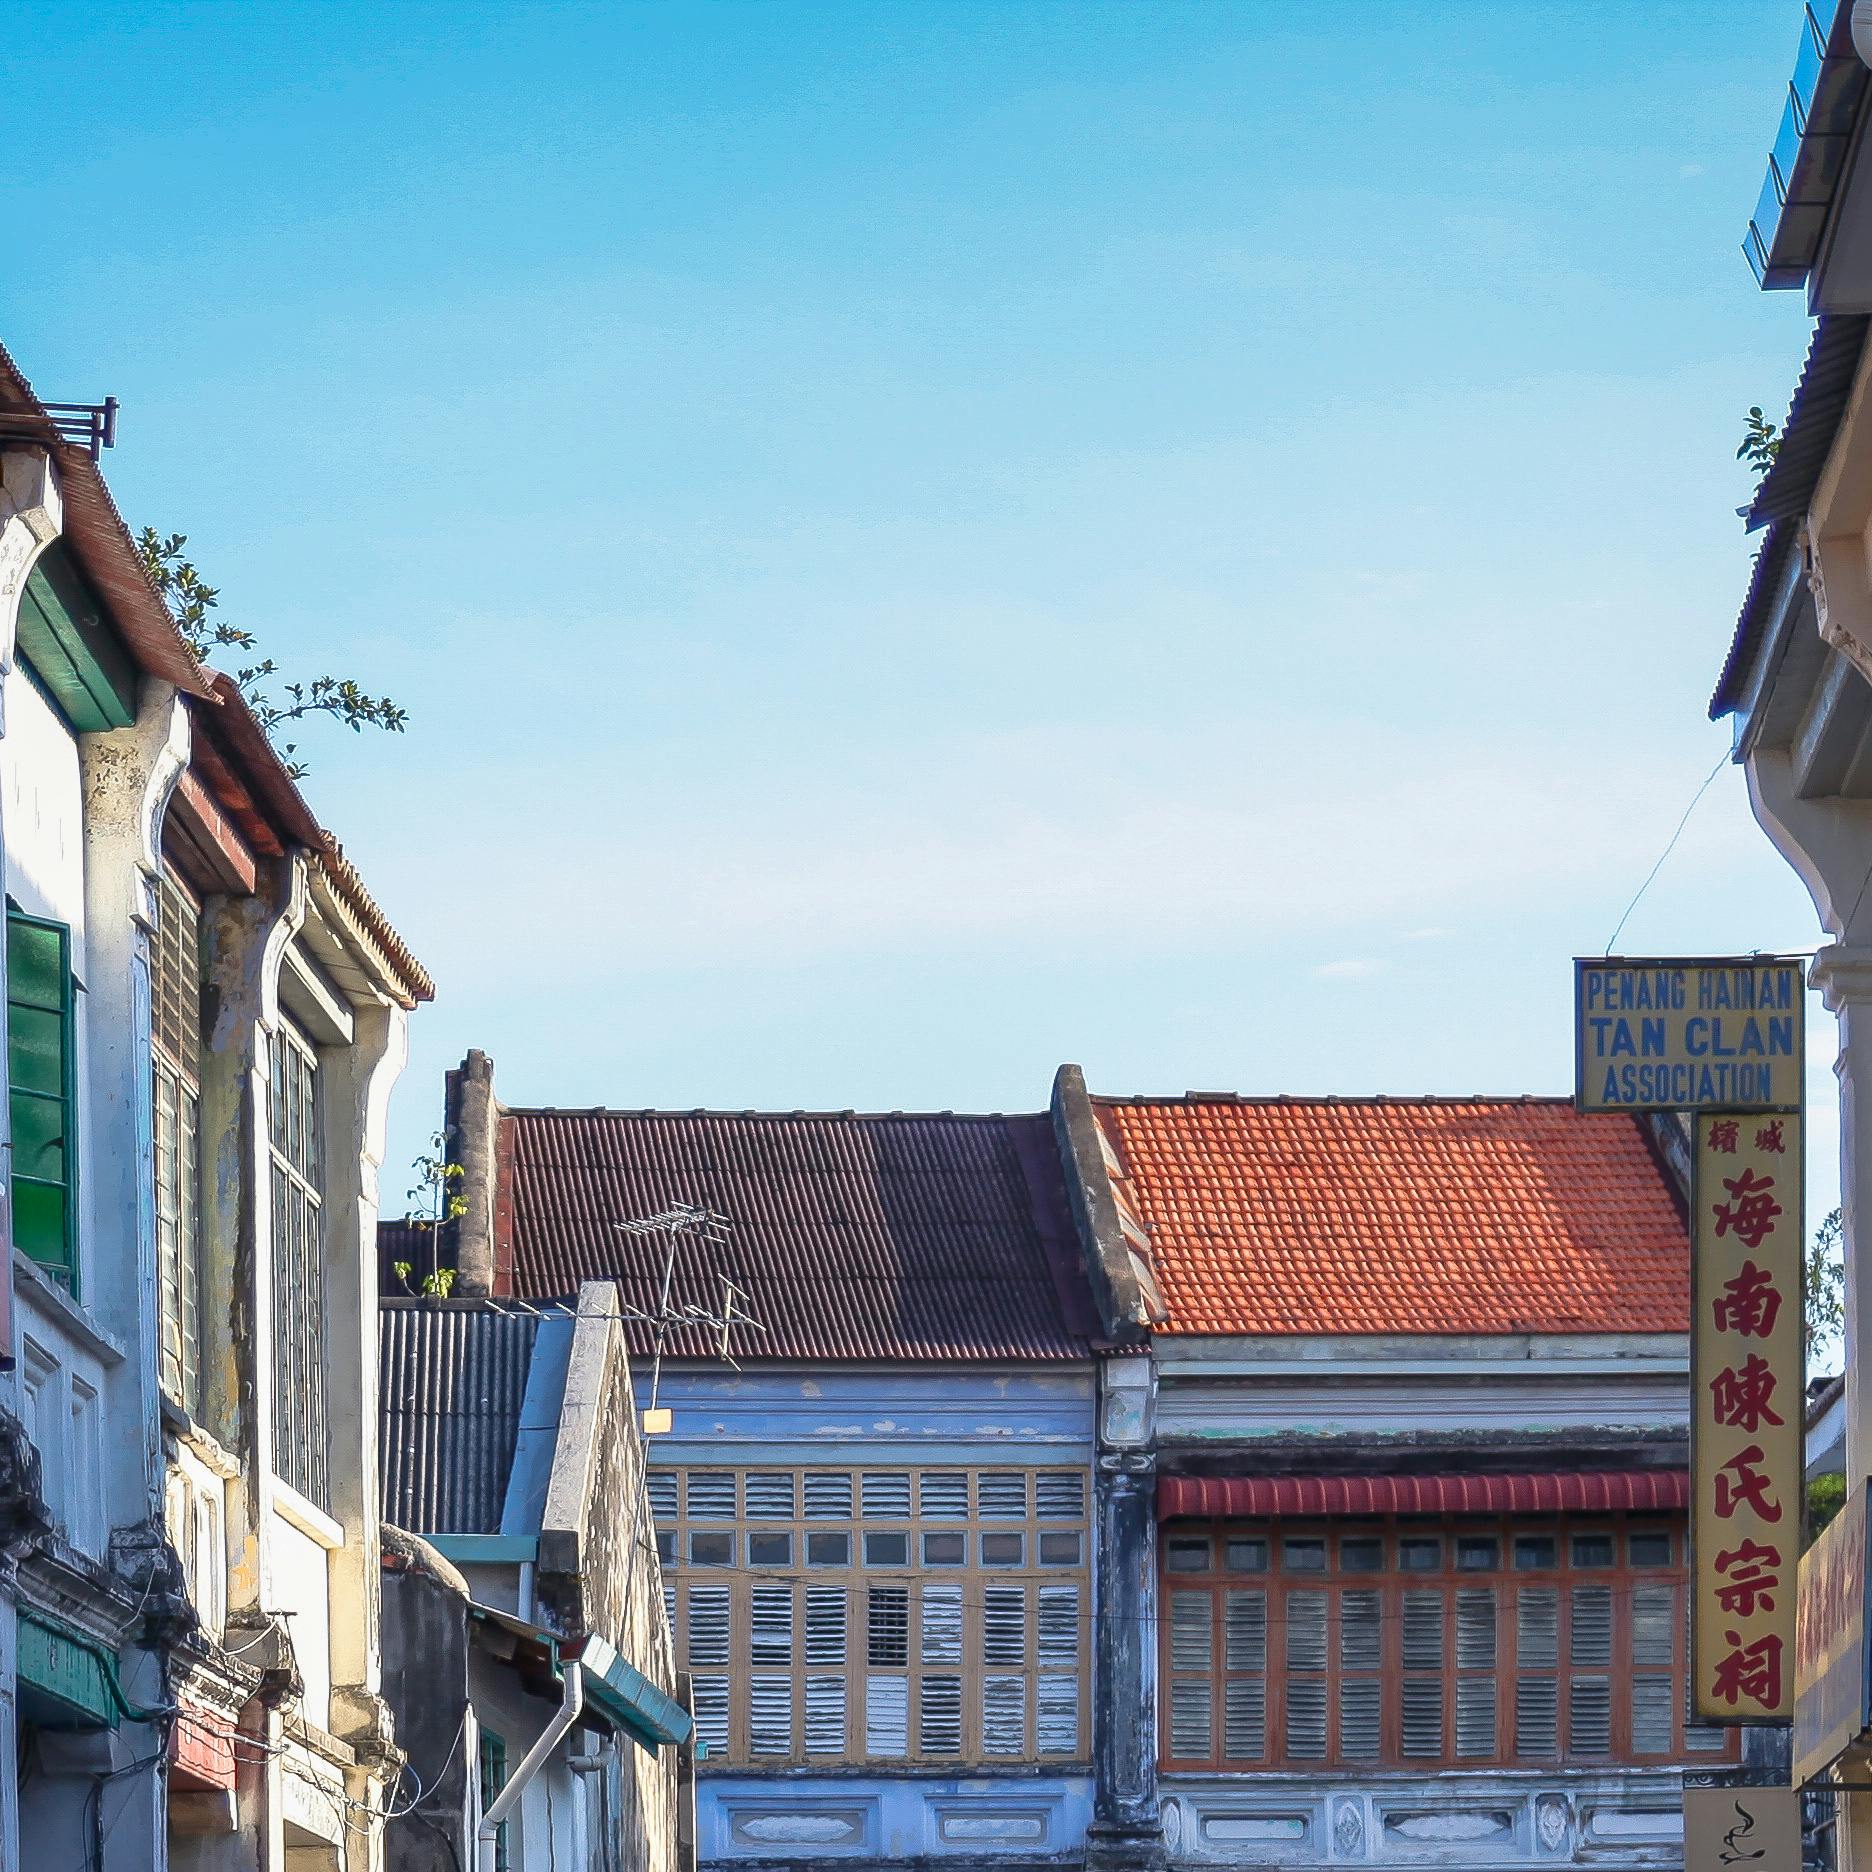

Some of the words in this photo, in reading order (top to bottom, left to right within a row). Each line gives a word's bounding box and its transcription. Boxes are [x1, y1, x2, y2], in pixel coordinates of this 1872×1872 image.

[1587, 969, 1686, 1010] PENANG
[1698, 969, 1792, 1010] HAINAN
[1589, 1016, 1666, 1057] TAN
[1684, 1015, 1793, 1057] CLAN
[1601, 1063, 1771, 1104] ASSOCIATION
[1708, 1166, 1786, 1711] 海南陳氏宗祠
